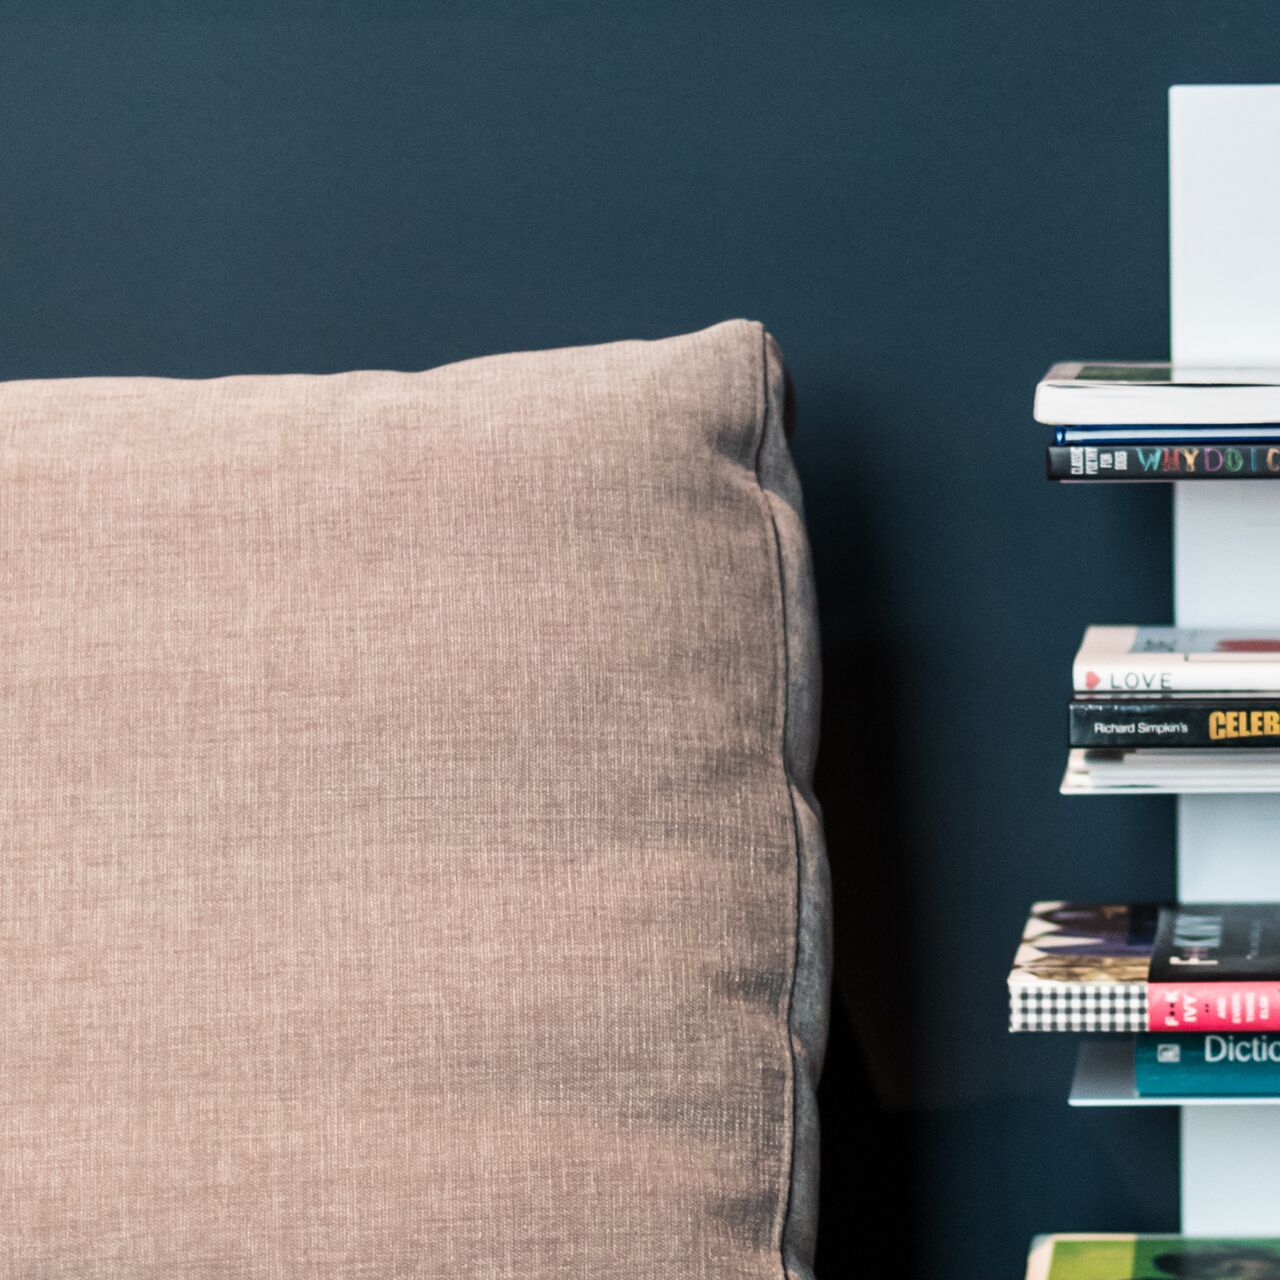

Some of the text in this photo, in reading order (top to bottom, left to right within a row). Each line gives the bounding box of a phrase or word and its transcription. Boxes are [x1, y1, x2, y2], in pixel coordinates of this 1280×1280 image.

[1135, 447, 1199, 472] WHY
[1203, 447, 1243, 472] DO
[1110, 673, 1173, 690] LOVE
[1094, 723, 1188, 738] Richard Simpkin's
[1184, 994, 1197, 1022] IVY
